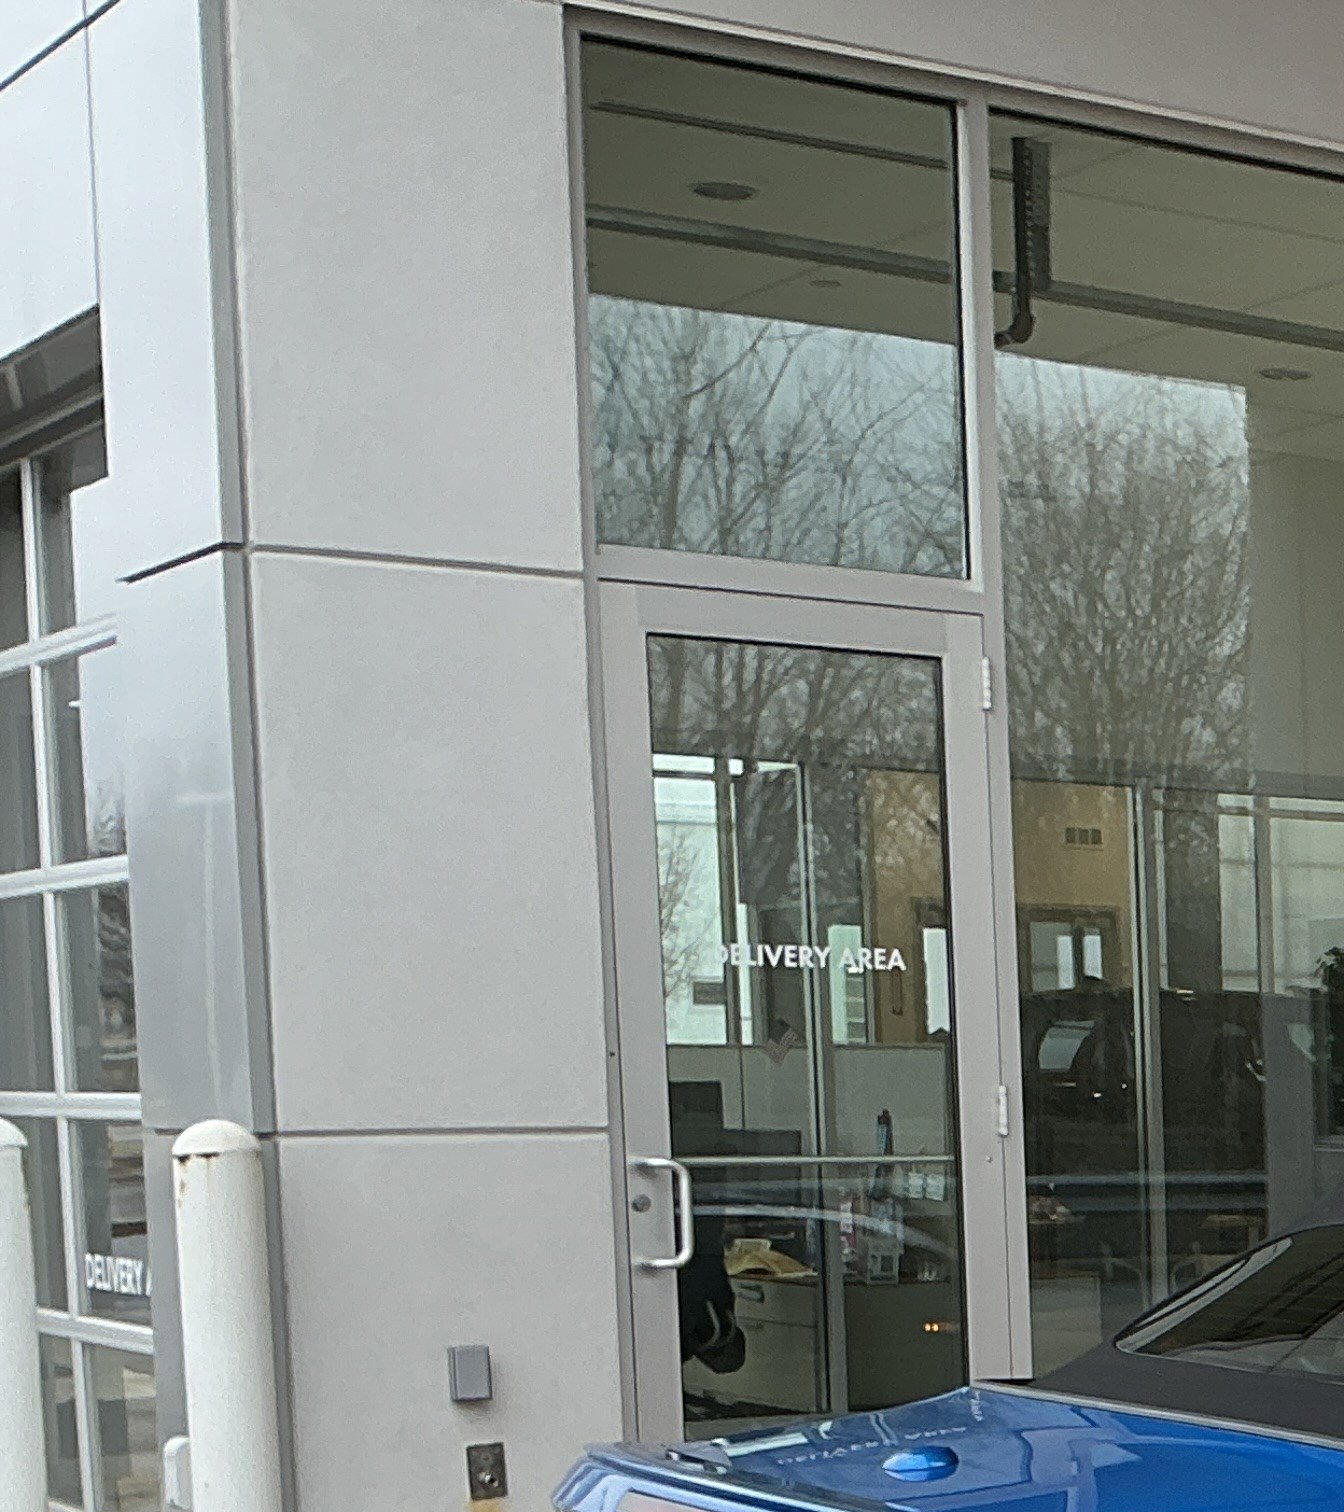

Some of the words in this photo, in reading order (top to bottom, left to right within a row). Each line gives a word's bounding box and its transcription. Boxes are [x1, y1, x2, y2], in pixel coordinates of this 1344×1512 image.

[716, 943, 831, 968] DELIVERY
[839, 948, 906, 972] AREA
[85, 1253, 143, 1295] DELIVERY
